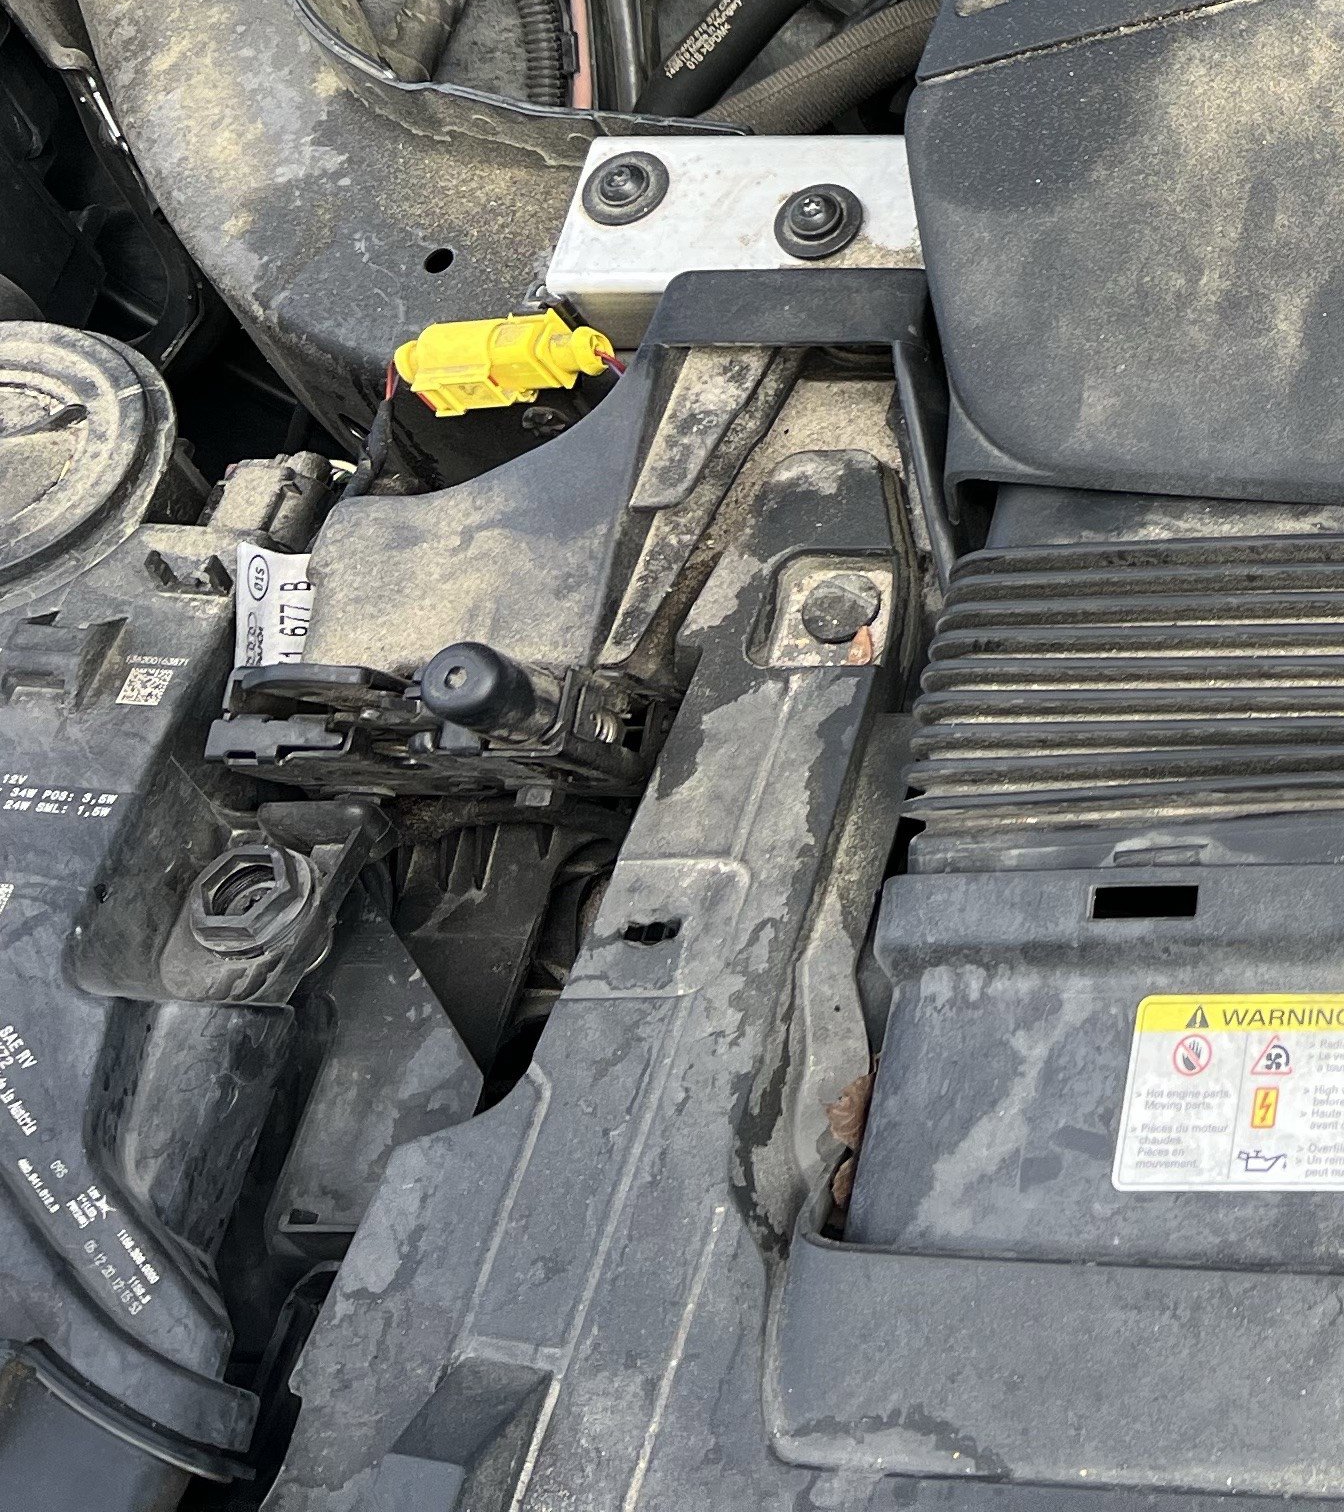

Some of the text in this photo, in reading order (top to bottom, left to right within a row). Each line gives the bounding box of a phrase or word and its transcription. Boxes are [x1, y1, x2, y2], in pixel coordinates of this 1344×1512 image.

[279, 581, 312, 592] B
[279, 603, 311, 637] 677
[2, 774, 29, 785] 12V
[9, 787, 39, 800] 34W
[41, 789, 75, 802] POS:
[2, 799, 112, 817] 24W SML: 1,5W
[1318, 1051, 1331, 1061] Le
[1146, 1088, 1164, 1098] Hot
[1167, 1089, 1201, 1100] engine
[1314, 1086, 1339, 1098] High
[1144, 1100, 1182, 1112] Moving
[1311, 1109, 1342, 1119] Haute
[1175, 1123, 1189, 1133] du
[1192, 1124, 1228, 1133] moteur
[1310, 1121, 1338, 1130] avant
[1171, 1148, 1185, 1157] en
[1306, 1156, 1322, 1165] Un
[1304, 1168, 1328, 1178] peut
